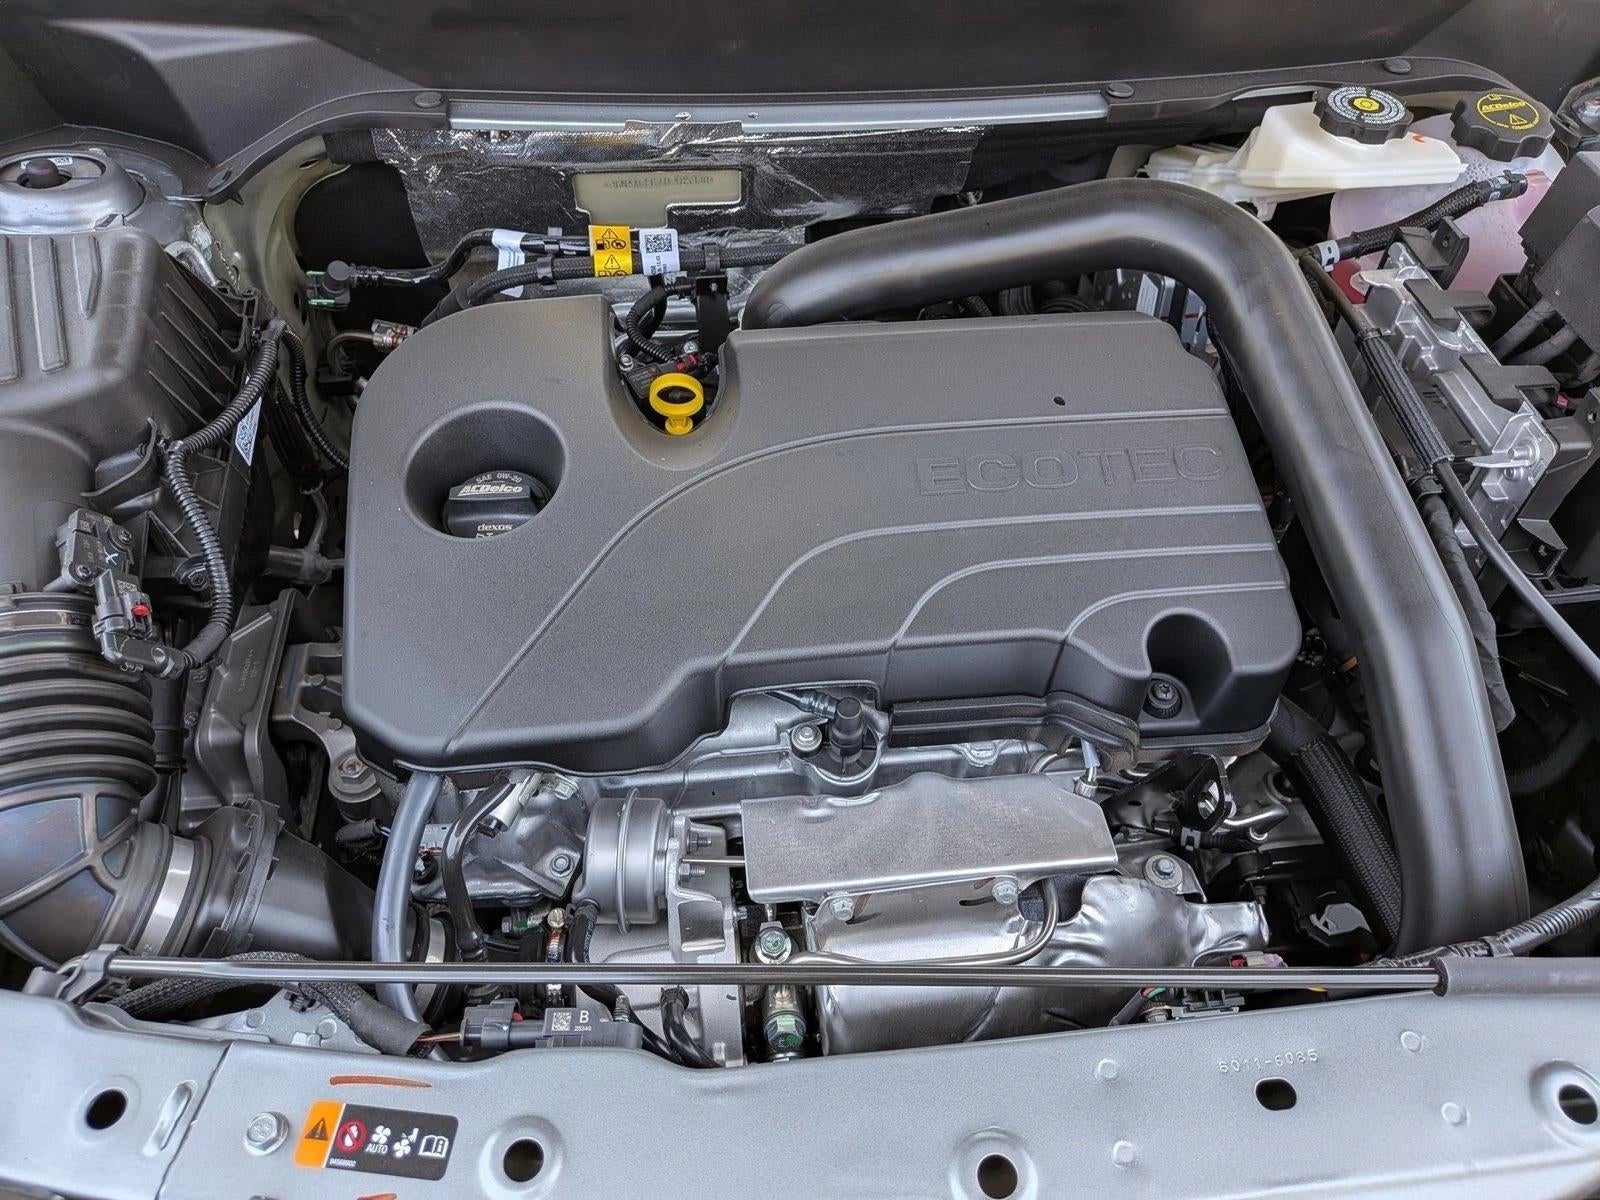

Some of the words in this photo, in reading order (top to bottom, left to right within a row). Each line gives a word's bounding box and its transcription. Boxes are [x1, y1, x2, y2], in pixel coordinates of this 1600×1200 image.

[1481, 101, 1526, 113] ACDelco
[916, 442, 1225, 497] ECOTEC
[475, 474, 492, 484] SAE
[496, 472, 522, 483] 0W-20
[457, 484, 523, 496] ACDelco
[477, 523, 513, 532] dexos
[579, 1011, 589, 1023] B
[365, 1143, 388, 1154] AUTO
